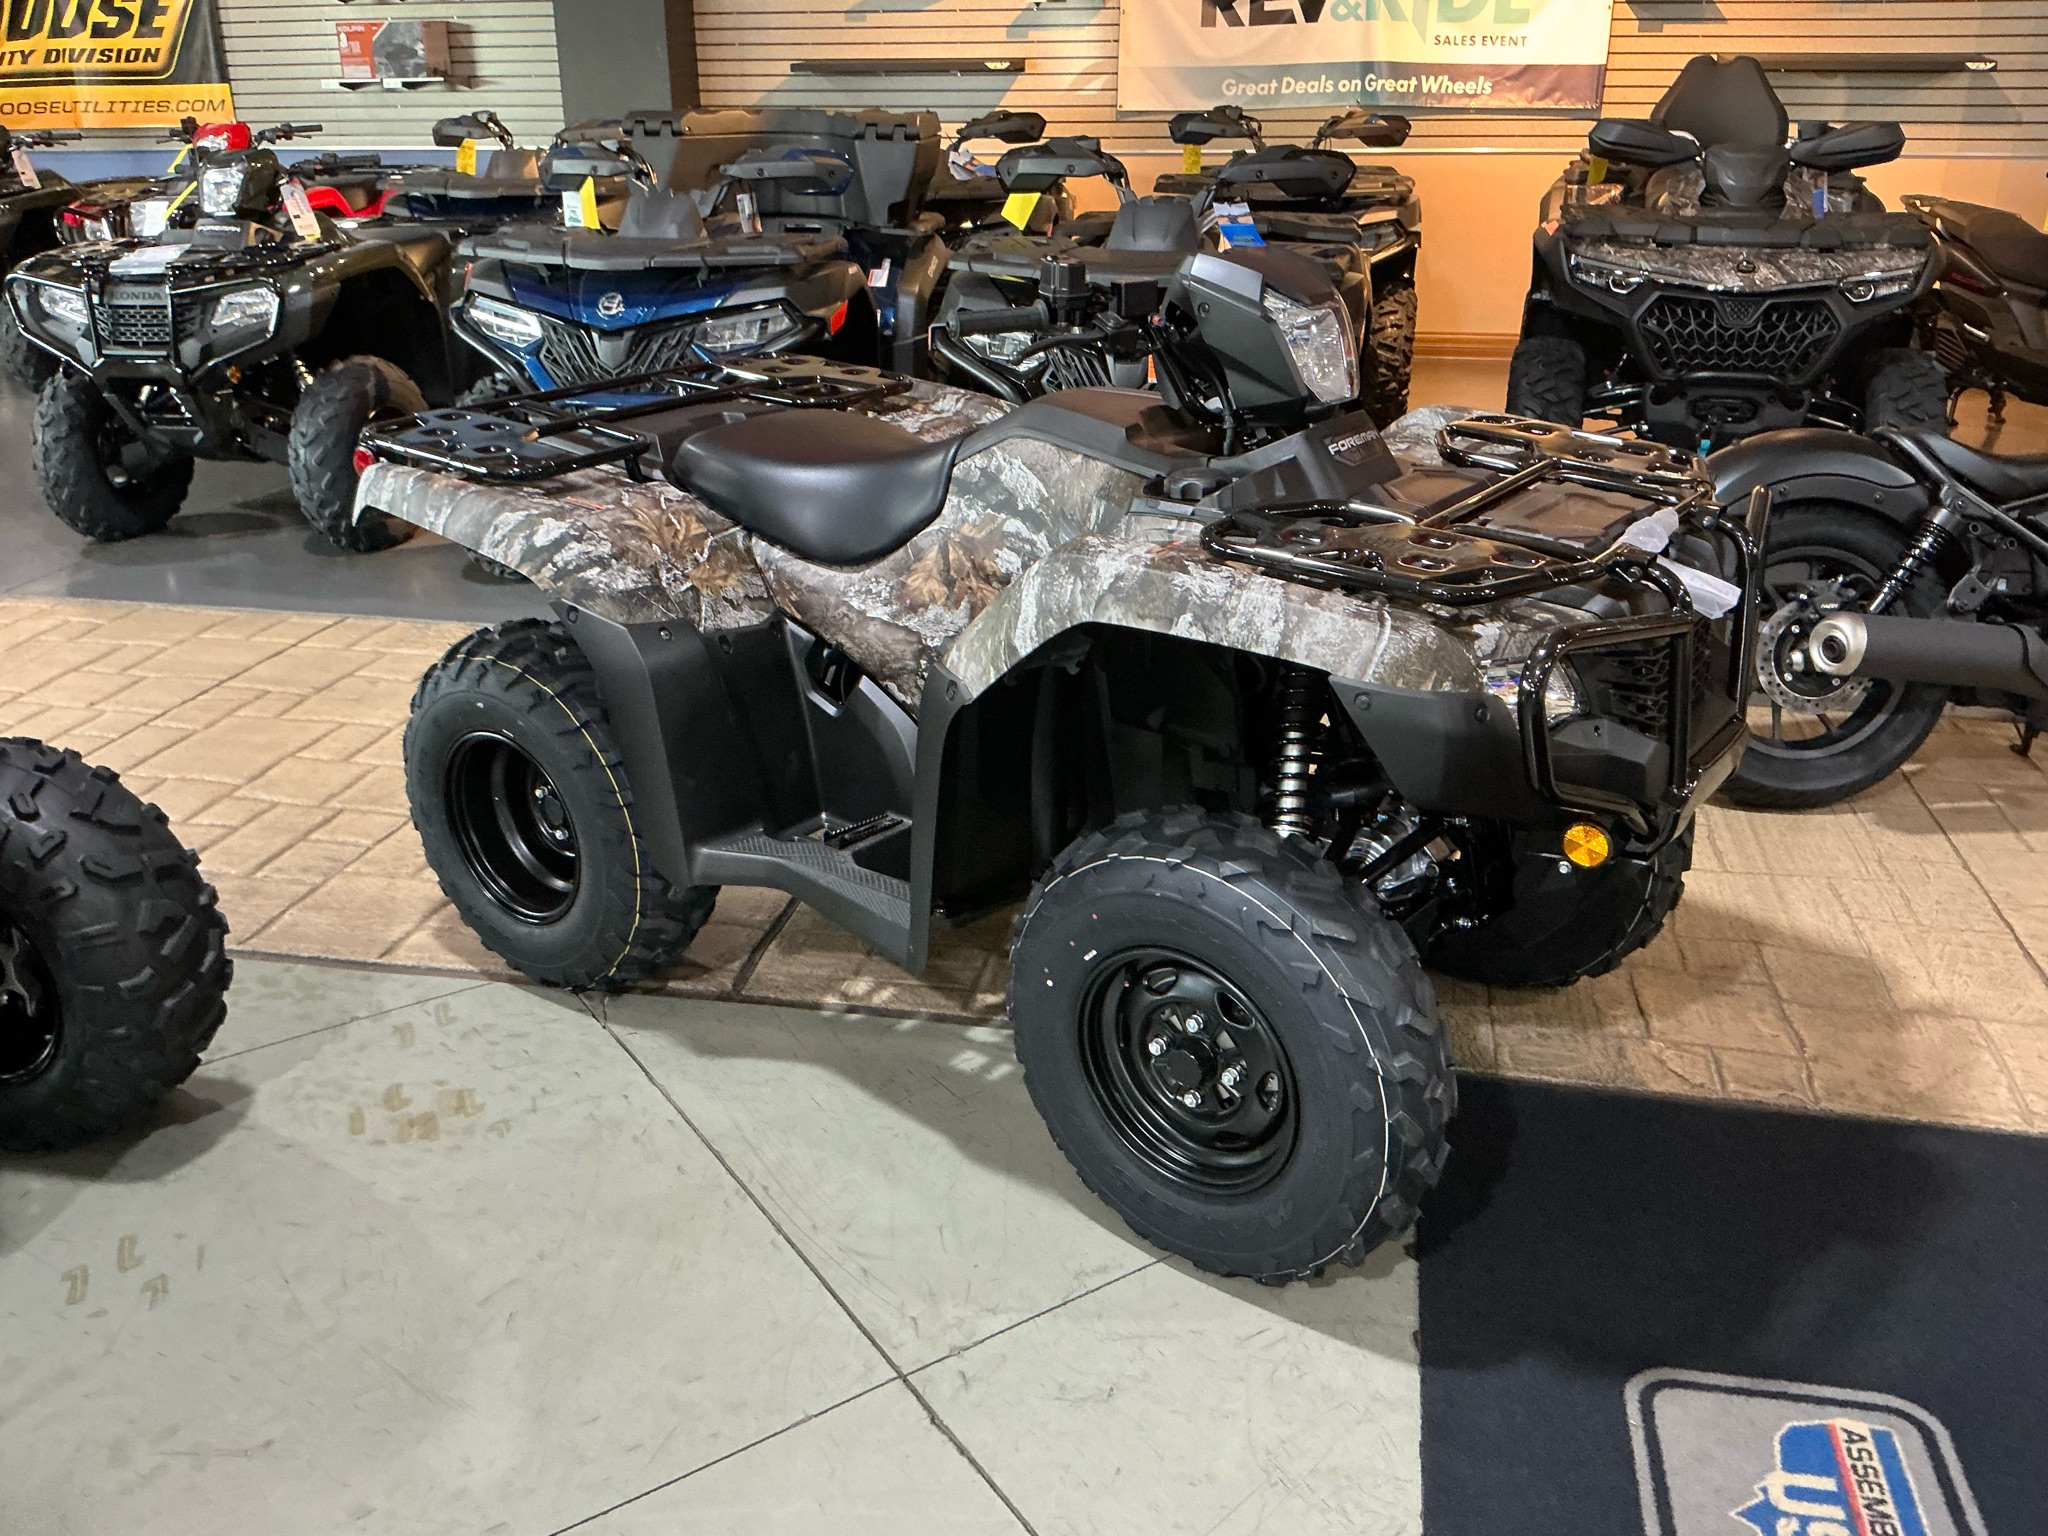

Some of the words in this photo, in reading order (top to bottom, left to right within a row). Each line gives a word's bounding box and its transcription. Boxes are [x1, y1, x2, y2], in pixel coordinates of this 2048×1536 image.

[1433, 34, 1476, 46] SALES
[1481, 35, 1528, 46] EVENT
[43, 47, 162, 64] DIVISION
[1221, 78, 1279, 96] Great
[1281, 75, 1334, 94] Deals
[1338, 81, 1361, 92] on
[1365, 73, 1418, 92] Great
[1420, 75, 1493, 95] Wheels
[1327, 429, 1380, 455] FOREMAN
